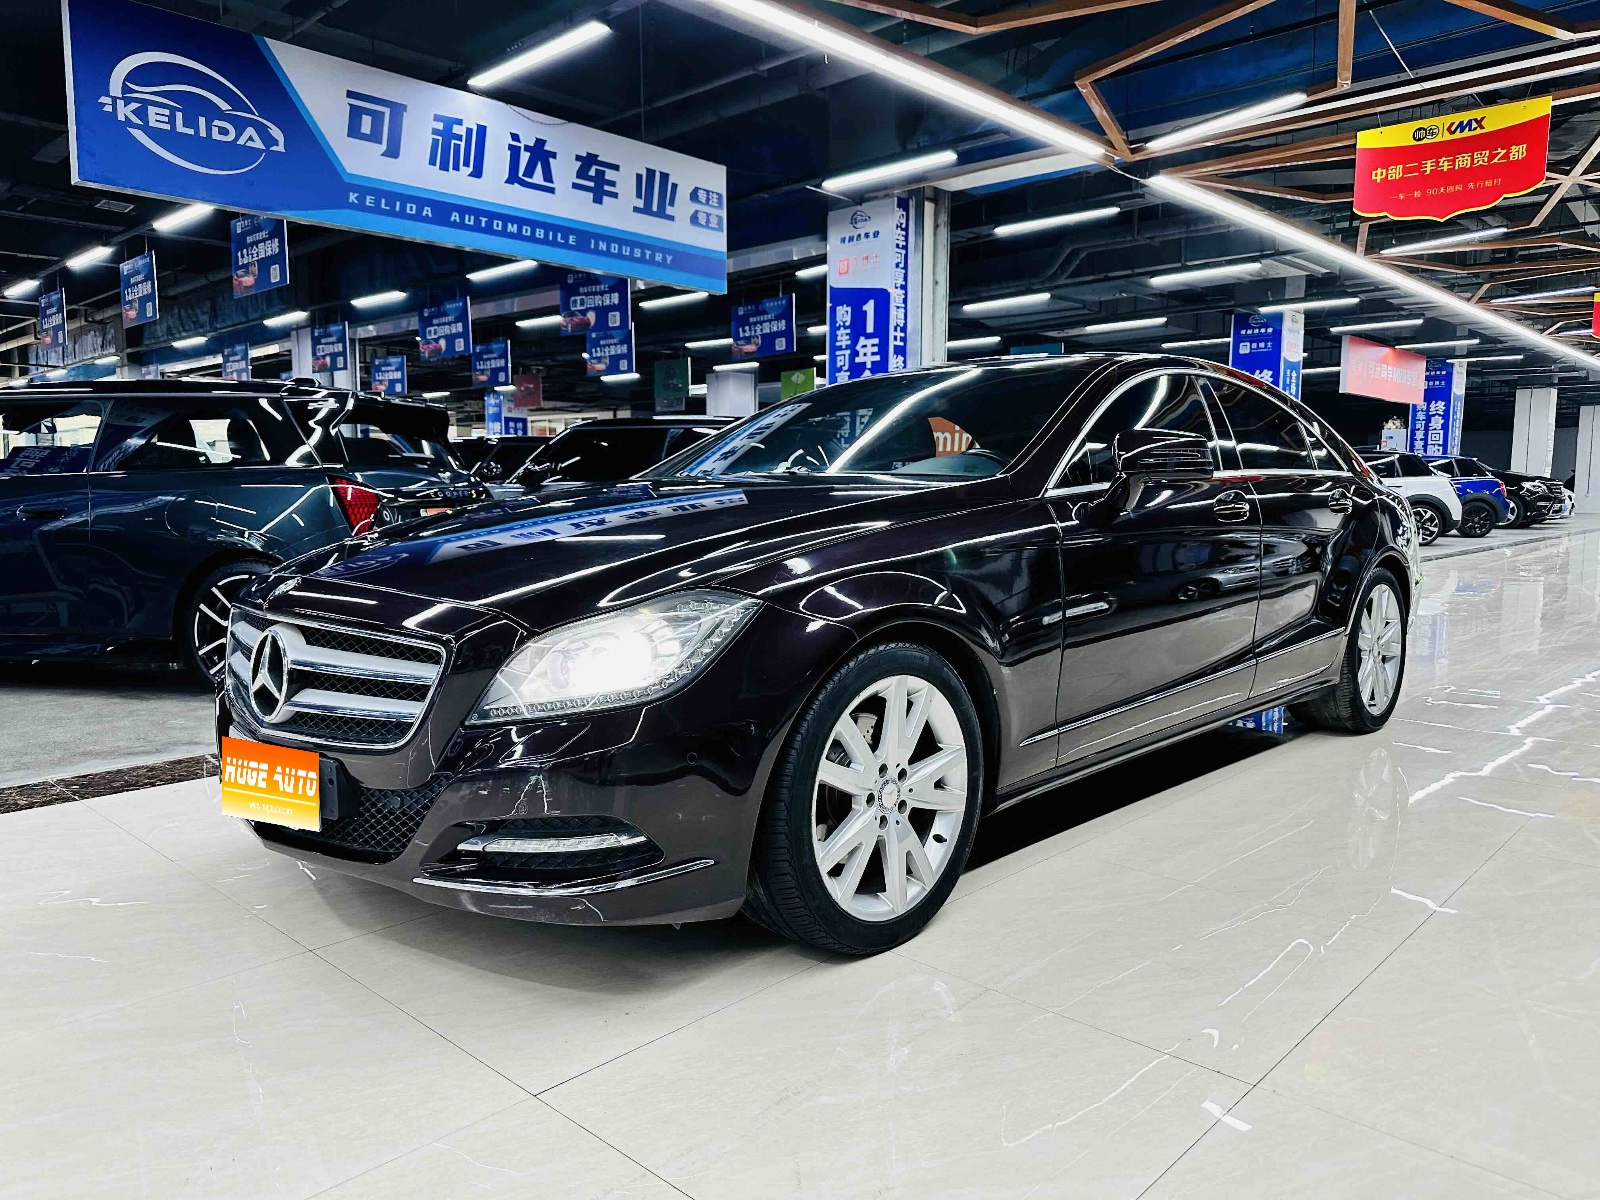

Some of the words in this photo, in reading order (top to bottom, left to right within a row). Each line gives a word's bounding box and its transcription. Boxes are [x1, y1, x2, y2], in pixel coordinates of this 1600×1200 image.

[117, 98, 266, 150] KELIDA
[346, 89, 678, 222] 可利达车业
[1371, 143, 1527, 183] 中部二手车商贸之都
[696, 188, 720, 207] 专注
[696, 211, 720, 229] 专业
[349, 191, 433, 218] KELIDA
[450, 214, 577, 245] AUTOMOBILE
[590, 239, 674, 264] INDUSTRY
